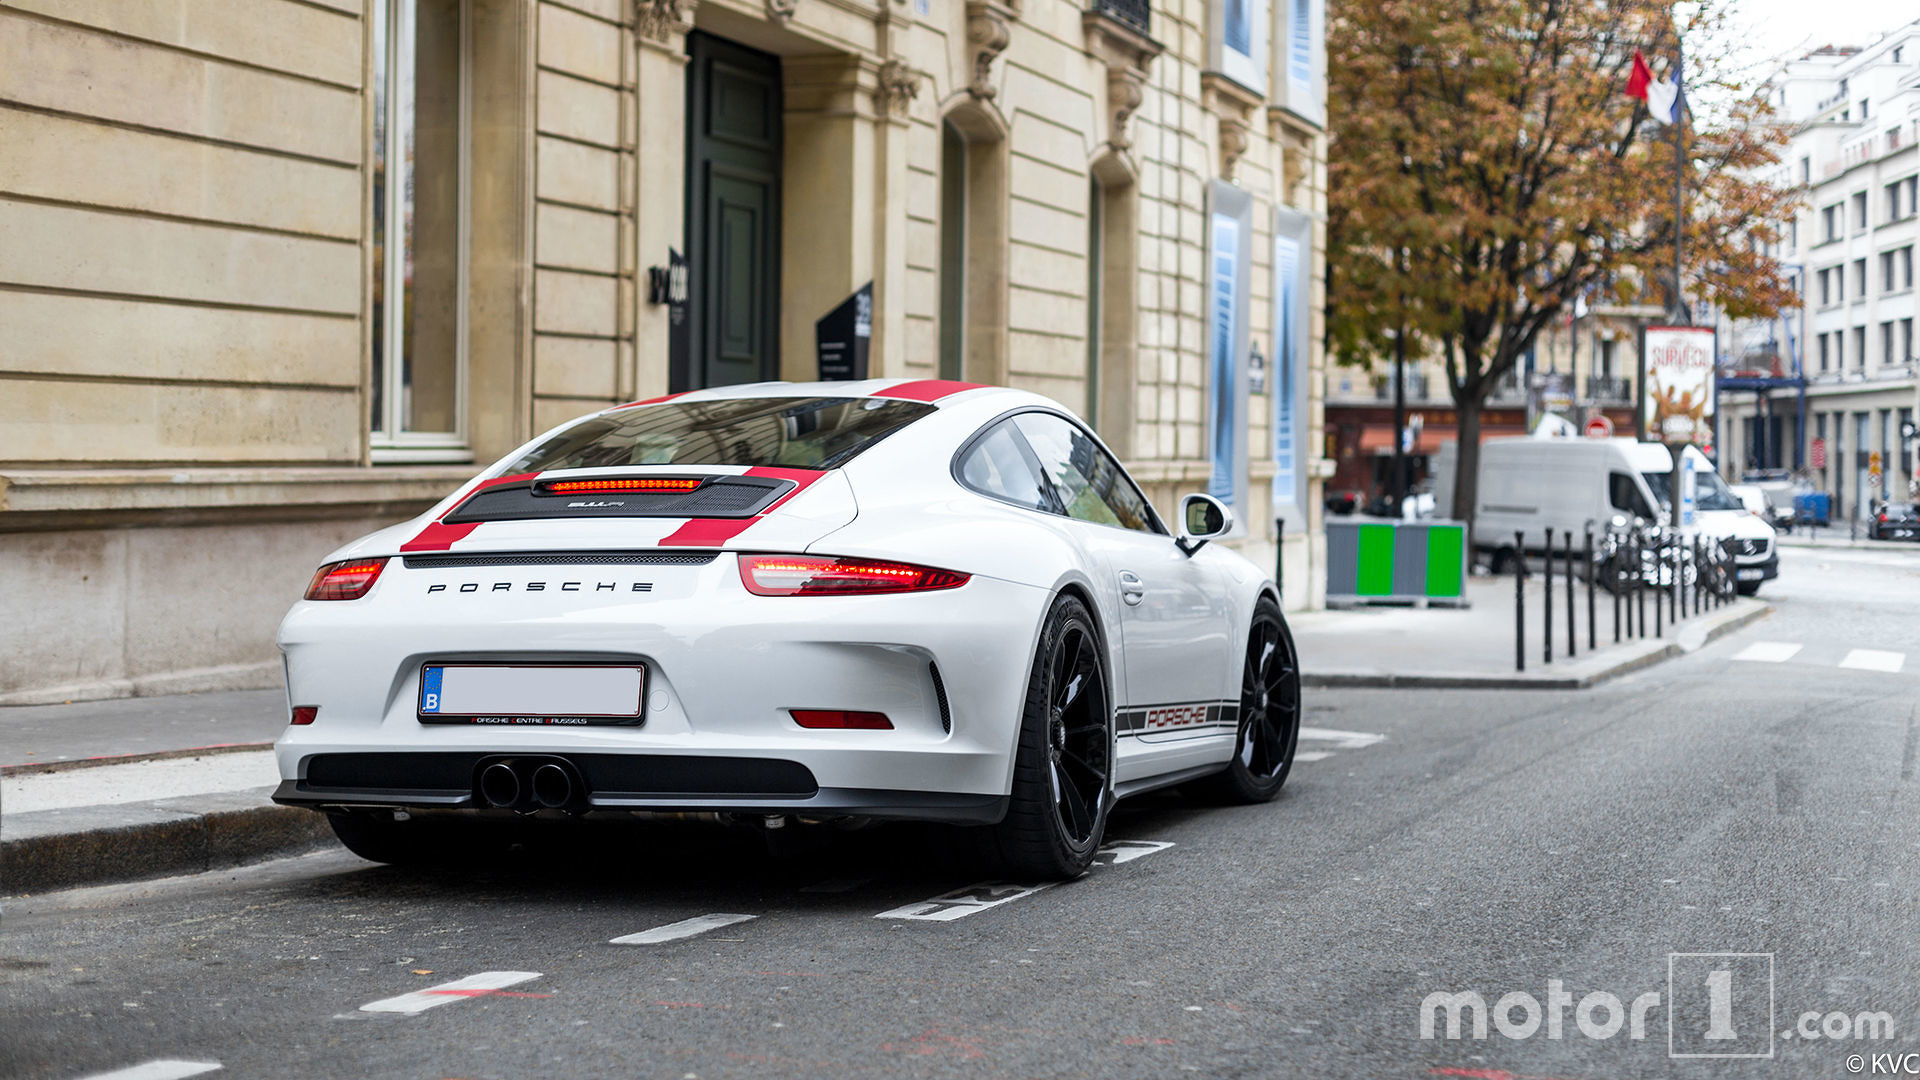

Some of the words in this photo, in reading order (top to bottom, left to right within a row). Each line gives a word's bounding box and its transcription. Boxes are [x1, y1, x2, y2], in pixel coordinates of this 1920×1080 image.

[427, 581, 654, 594] PORSCHE
[426, 693, 438, 709] B
[1147, 706, 1206, 729] PORSCHE
